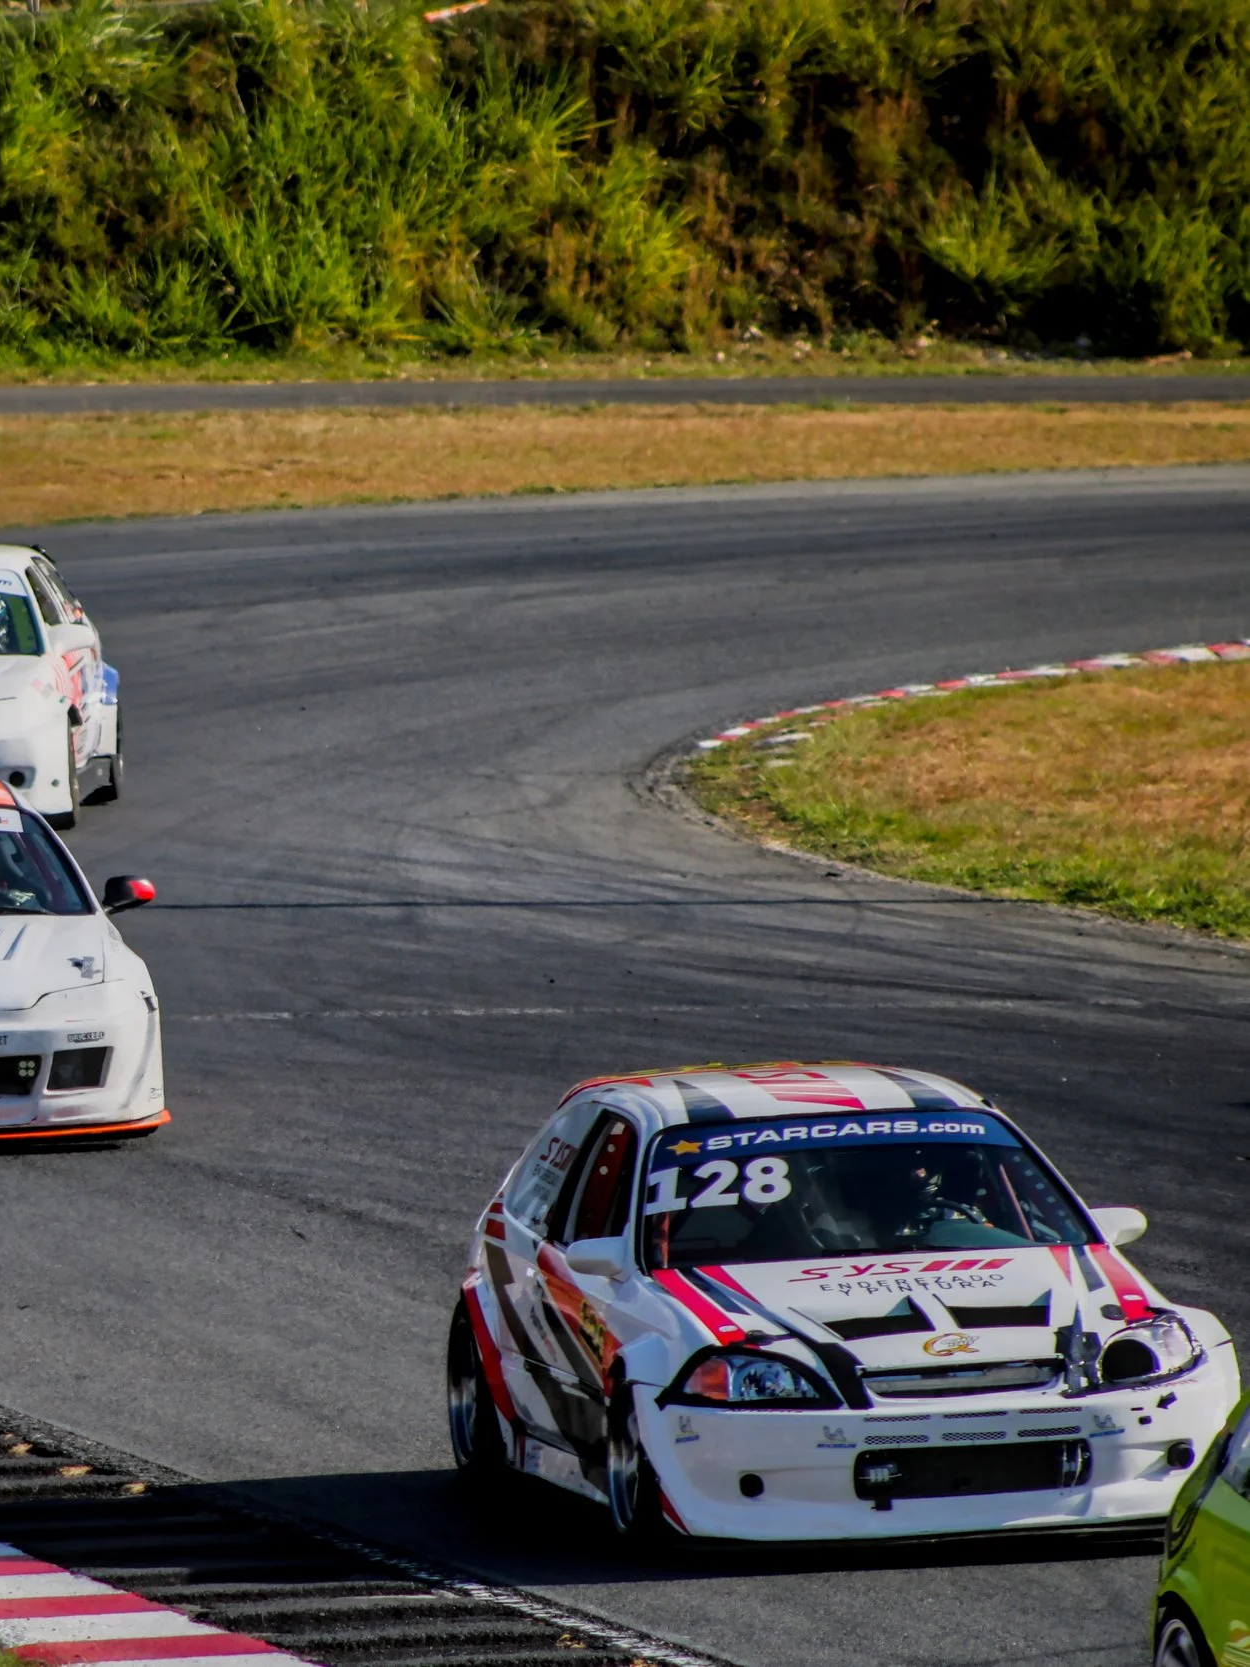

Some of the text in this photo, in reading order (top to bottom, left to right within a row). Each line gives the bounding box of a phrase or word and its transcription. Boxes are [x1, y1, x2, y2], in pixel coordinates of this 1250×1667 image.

[706, 1119, 986, 1152] STARCARS.com
[645, 1157, 792, 1215] 128
[819, 1273, 1005, 1292] ENDEREZADO
[867, 1281, 998, 1295] PINTURA
